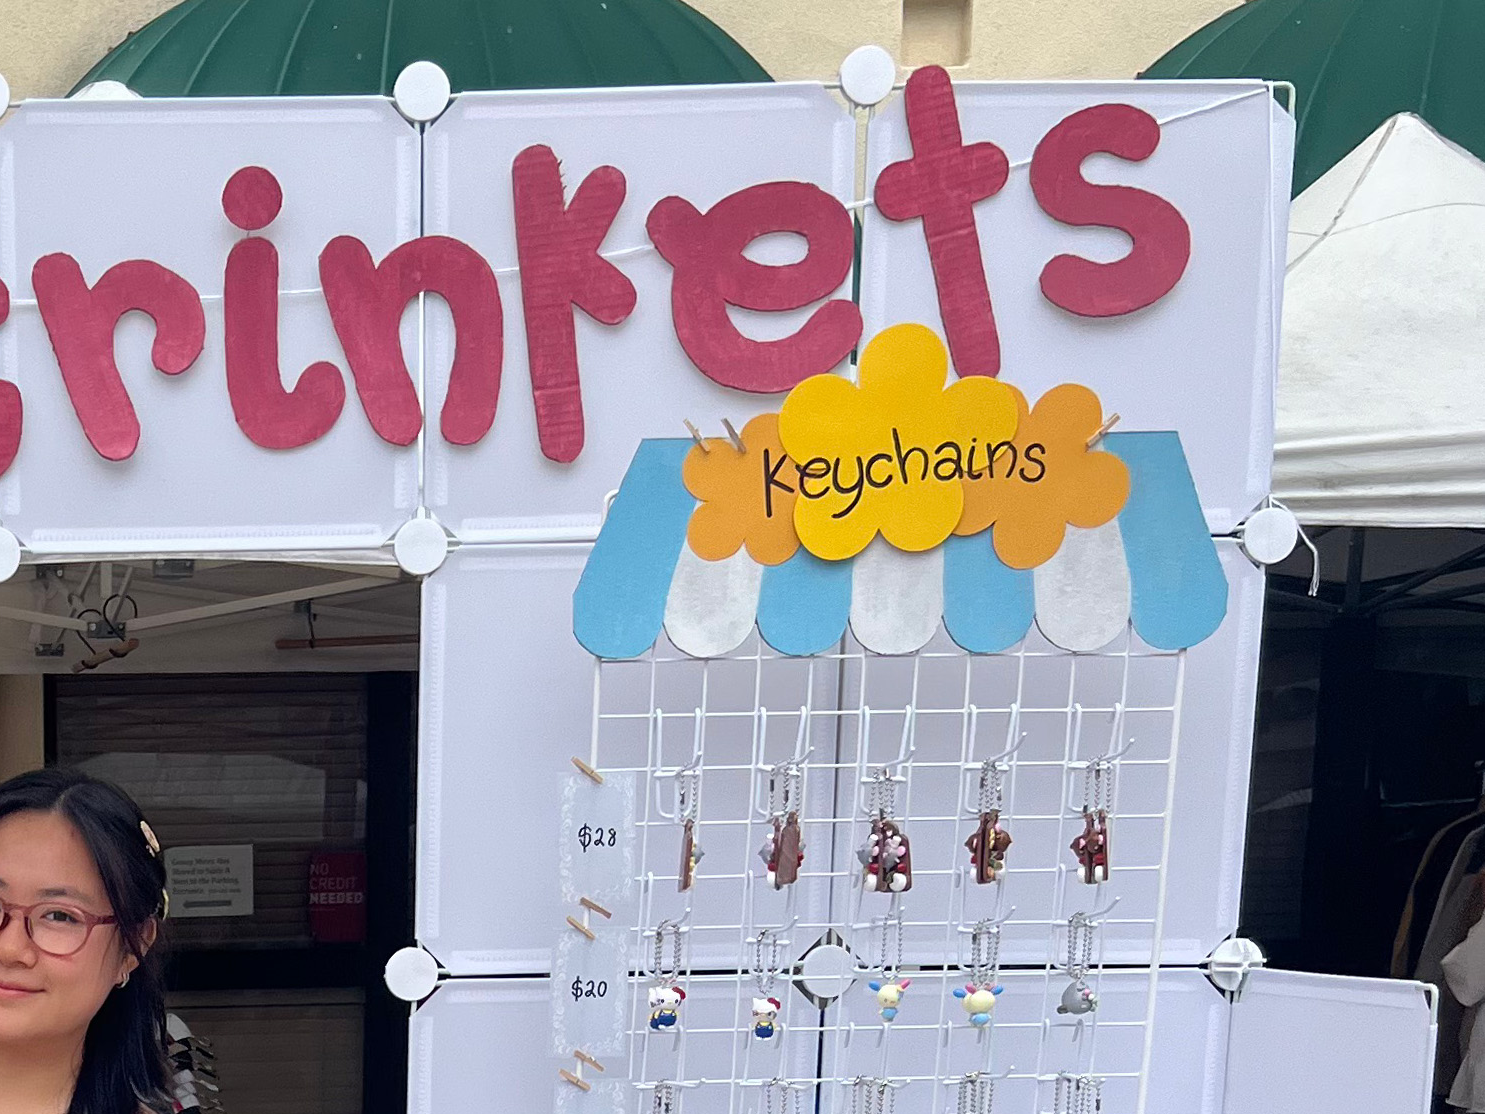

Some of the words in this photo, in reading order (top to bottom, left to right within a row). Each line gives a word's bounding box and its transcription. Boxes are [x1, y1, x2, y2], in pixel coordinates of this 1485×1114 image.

[578, 822, 617, 853] $28
[310, 863, 329, 876] NO
[309, 877, 358, 890] CREDIT
[309, 891, 363, 904] NEEDED
[571, 976, 608, 1003] $20
